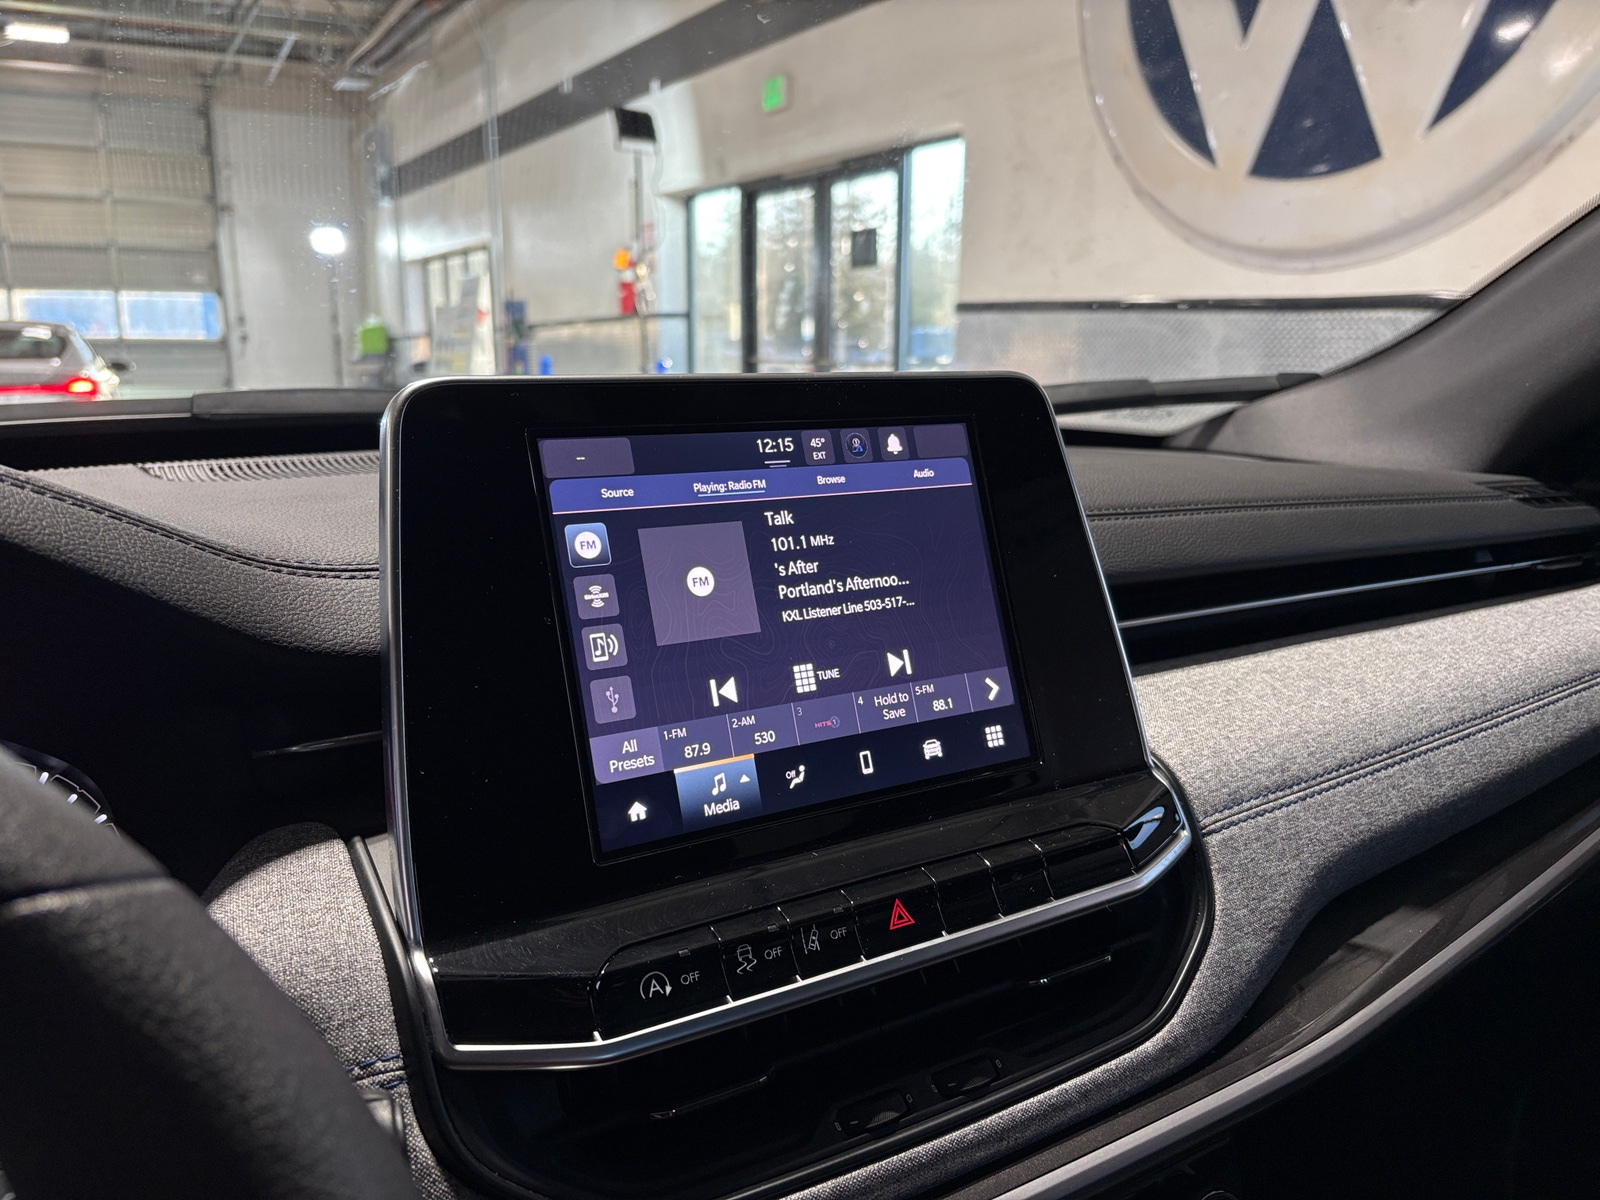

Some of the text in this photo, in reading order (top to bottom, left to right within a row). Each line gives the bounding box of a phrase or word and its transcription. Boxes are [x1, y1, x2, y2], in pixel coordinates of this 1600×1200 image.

[756, 437, 795, 453] 12:15
[813, 451, 826, 461] EXT
[817, 475, 846, 486] Browse
[913, 468, 935, 479] Audio
[601, 487, 635, 499] Source
[693, 479, 767, 494] Playing: Radio FM
[764, 510, 795, 527] Talk
[579, 540, 597, 551] FM
[771, 534, 835, 552] 101.1 MHz
[788, 560, 819, 576] After
[692, 576, 710, 588] FM
[778, 578, 844, 600] Portland's
[781, 609, 804, 622] KXL
[803, 605, 842, 620] Listener
[843, 602, 864, 615] Line
[817, 668, 841, 680] TUNE
[915, 684, 935, 696] 5-FM
[857, 696, 864, 706] 4
[874, 692, 909, 707] Hold to
[932, 697, 954, 712] 88.1
[796, 706, 803, 717] 3
[883, 707, 907, 721] Save
[732, 715, 756, 728] 2-AM
[663, 727, 688, 741] 1-FM
[754, 730, 776, 745] 530
[622, 739, 638, 754] All
[684, 742, 711, 759] 87.9
[609, 753, 655, 774] Presets
[785, 769, 796, 780] Off
[703, 797, 741, 817] Media
[830, 926, 848, 940] OFF
[763, 946, 783, 960] OFF
[680, 970, 700, 986] OFF
